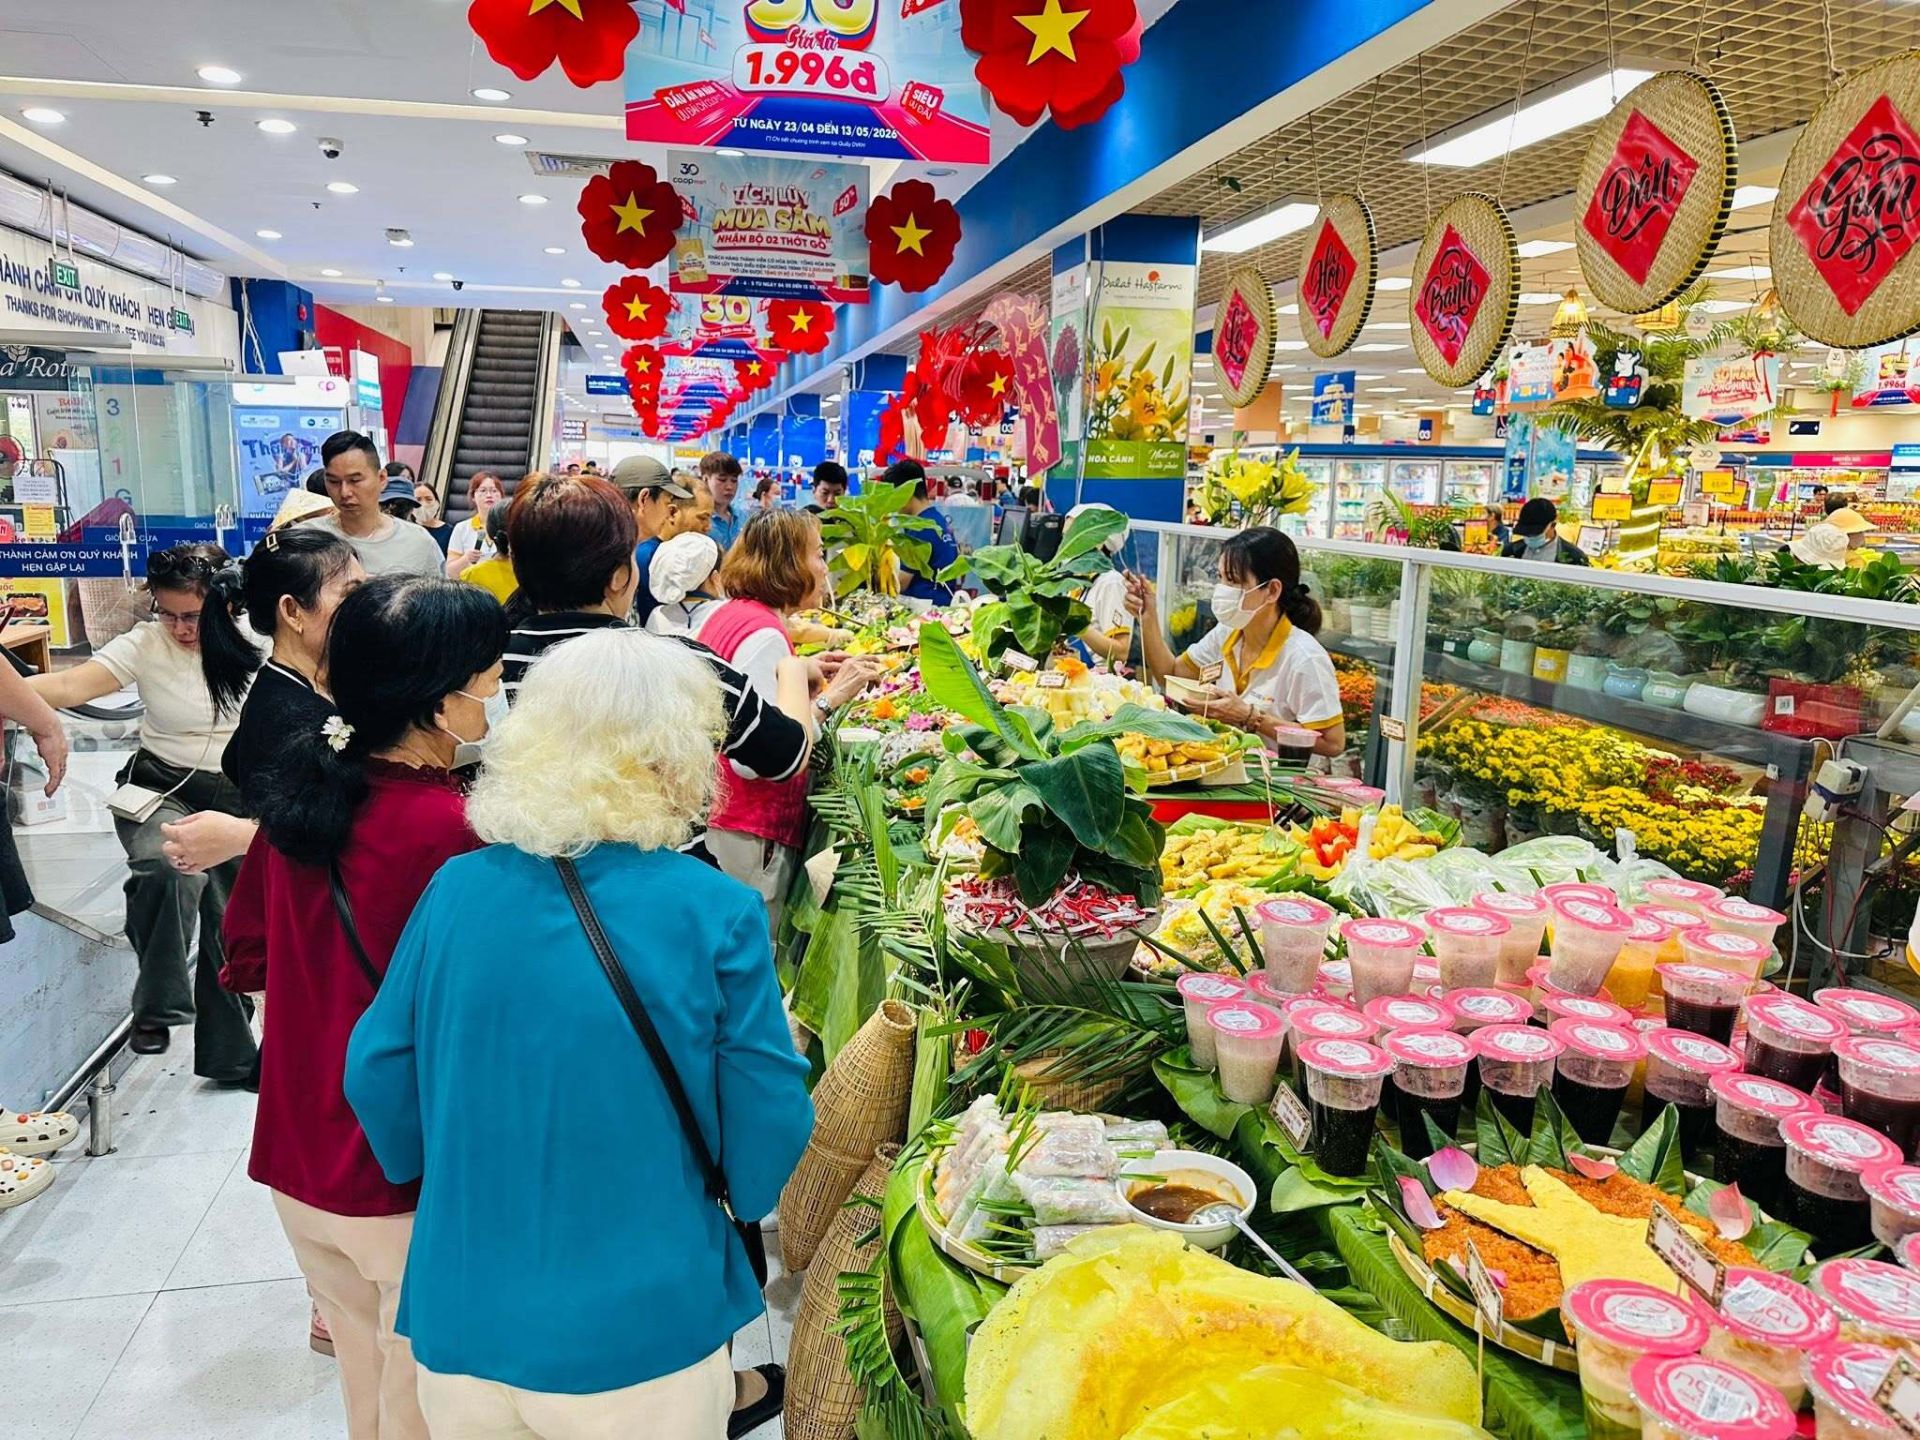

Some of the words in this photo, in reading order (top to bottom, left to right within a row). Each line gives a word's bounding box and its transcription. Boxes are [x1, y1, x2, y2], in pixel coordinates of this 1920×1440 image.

[746, 51, 877, 94] 1.996đ
[912, 89, 939, 108] SIÊU
[732, 116, 748, 128] TỪ
[750, 118, 781, 131] NGÀY
[784, 121, 815, 133] 23/04
[816, 121, 839, 135] ĐẾN
[842, 125, 898, 139] 13/05/2026
[679, 163, 700, 176] 30
[733, 183, 775, 206] TÍCH
[777, 184, 811, 208] LŨY
[1808, 133, 1920, 275] Gian
[712, 208, 770, 231] MUA
[774, 206, 832, 239] SẮM
[716, 235, 746, 247] NHẬN
[748, 234, 764, 245] BỘ
[765, 236, 779, 244] 02
[781, 236, 807, 247] THỚT
[56, 266, 76, 287] EXIT
[1102, 275, 1132, 289] Dalat
[1135, 279, 1182, 292] Hasfarm
[5, 294, 39, 317] THANKS
[40, 303, 57, 322] FOR
[57, 308, 94, 332] SHOPPING
[84, 285, 106, 310] QUÝ
[108, 292, 141, 320] KHÁCH
[147, 305, 165, 329] HẸN
[700, 294, 752, 325] 30
[176, 311, 190, 329] EXIT
[106, 398, 120, 416] 3
[1001, 424, 1014, 433] 03
[1418, 430, 1431, 439] 03
[1087, 454, 1107, 463] HOA
[1699, 450, 1713, 458] 30
[111, 458, 122, 475] 1
[114, 488, 133, 506] G
[34, 549, 58, 560] CẢM
[59, 550, 78, 560] ƠN
[79, 548, 100, 560] QUÝ
[21, 563, 43, 573] HẸN
[45, 563, 67, 574] GẶP
[69, 564, 85, 573] LẠI
